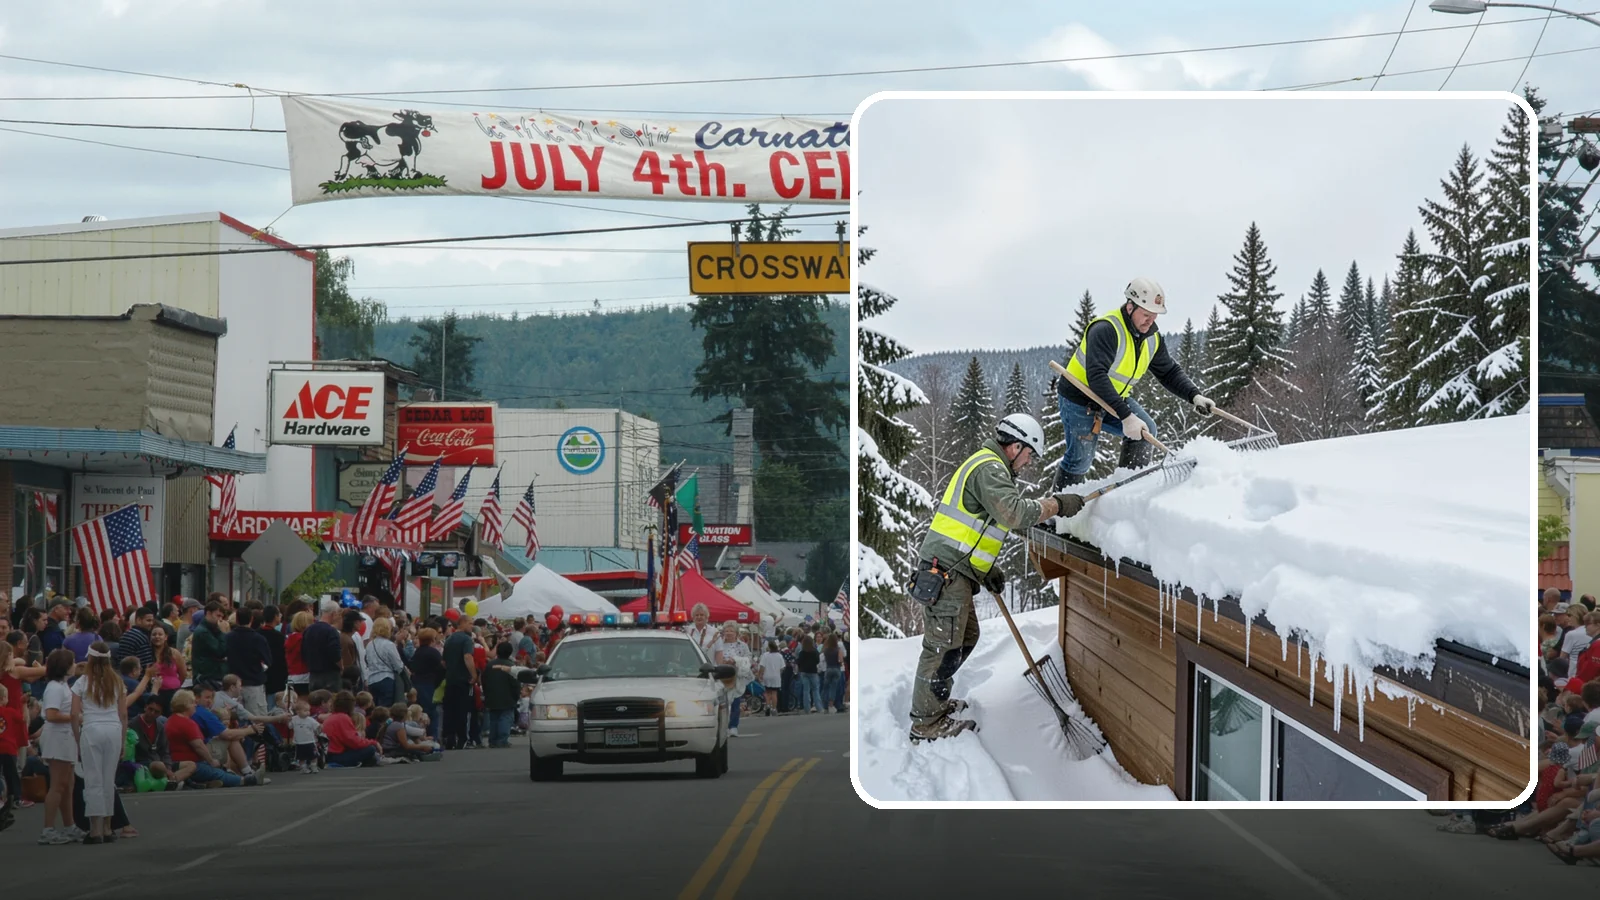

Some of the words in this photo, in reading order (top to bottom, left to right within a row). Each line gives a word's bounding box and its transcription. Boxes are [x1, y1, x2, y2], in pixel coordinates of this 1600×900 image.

[695, 121, 850, 150] Carnat
[481, 141, 605, 192] JULY
[632, 149, 746, 198] 4th.
[697, 254, 850, 280] CROSSWA
[283, 380, 373, 420] ACE
[405, 408, 453, 421] CEDAR
[461, 408, 485, 421] LOG
[283, 421, 371, 436] Hardware
[416, 427, 477, 447] Coca-Cola
[95, 485, 124, 495] Vincent
[126, 485, 136, 495] de
[137, 486, 155, 495] Paul
[81, 503, 154, 522] THT
[688, 526, 742, 535] CRNATION
[699, 535, 730, 543] GLASS
